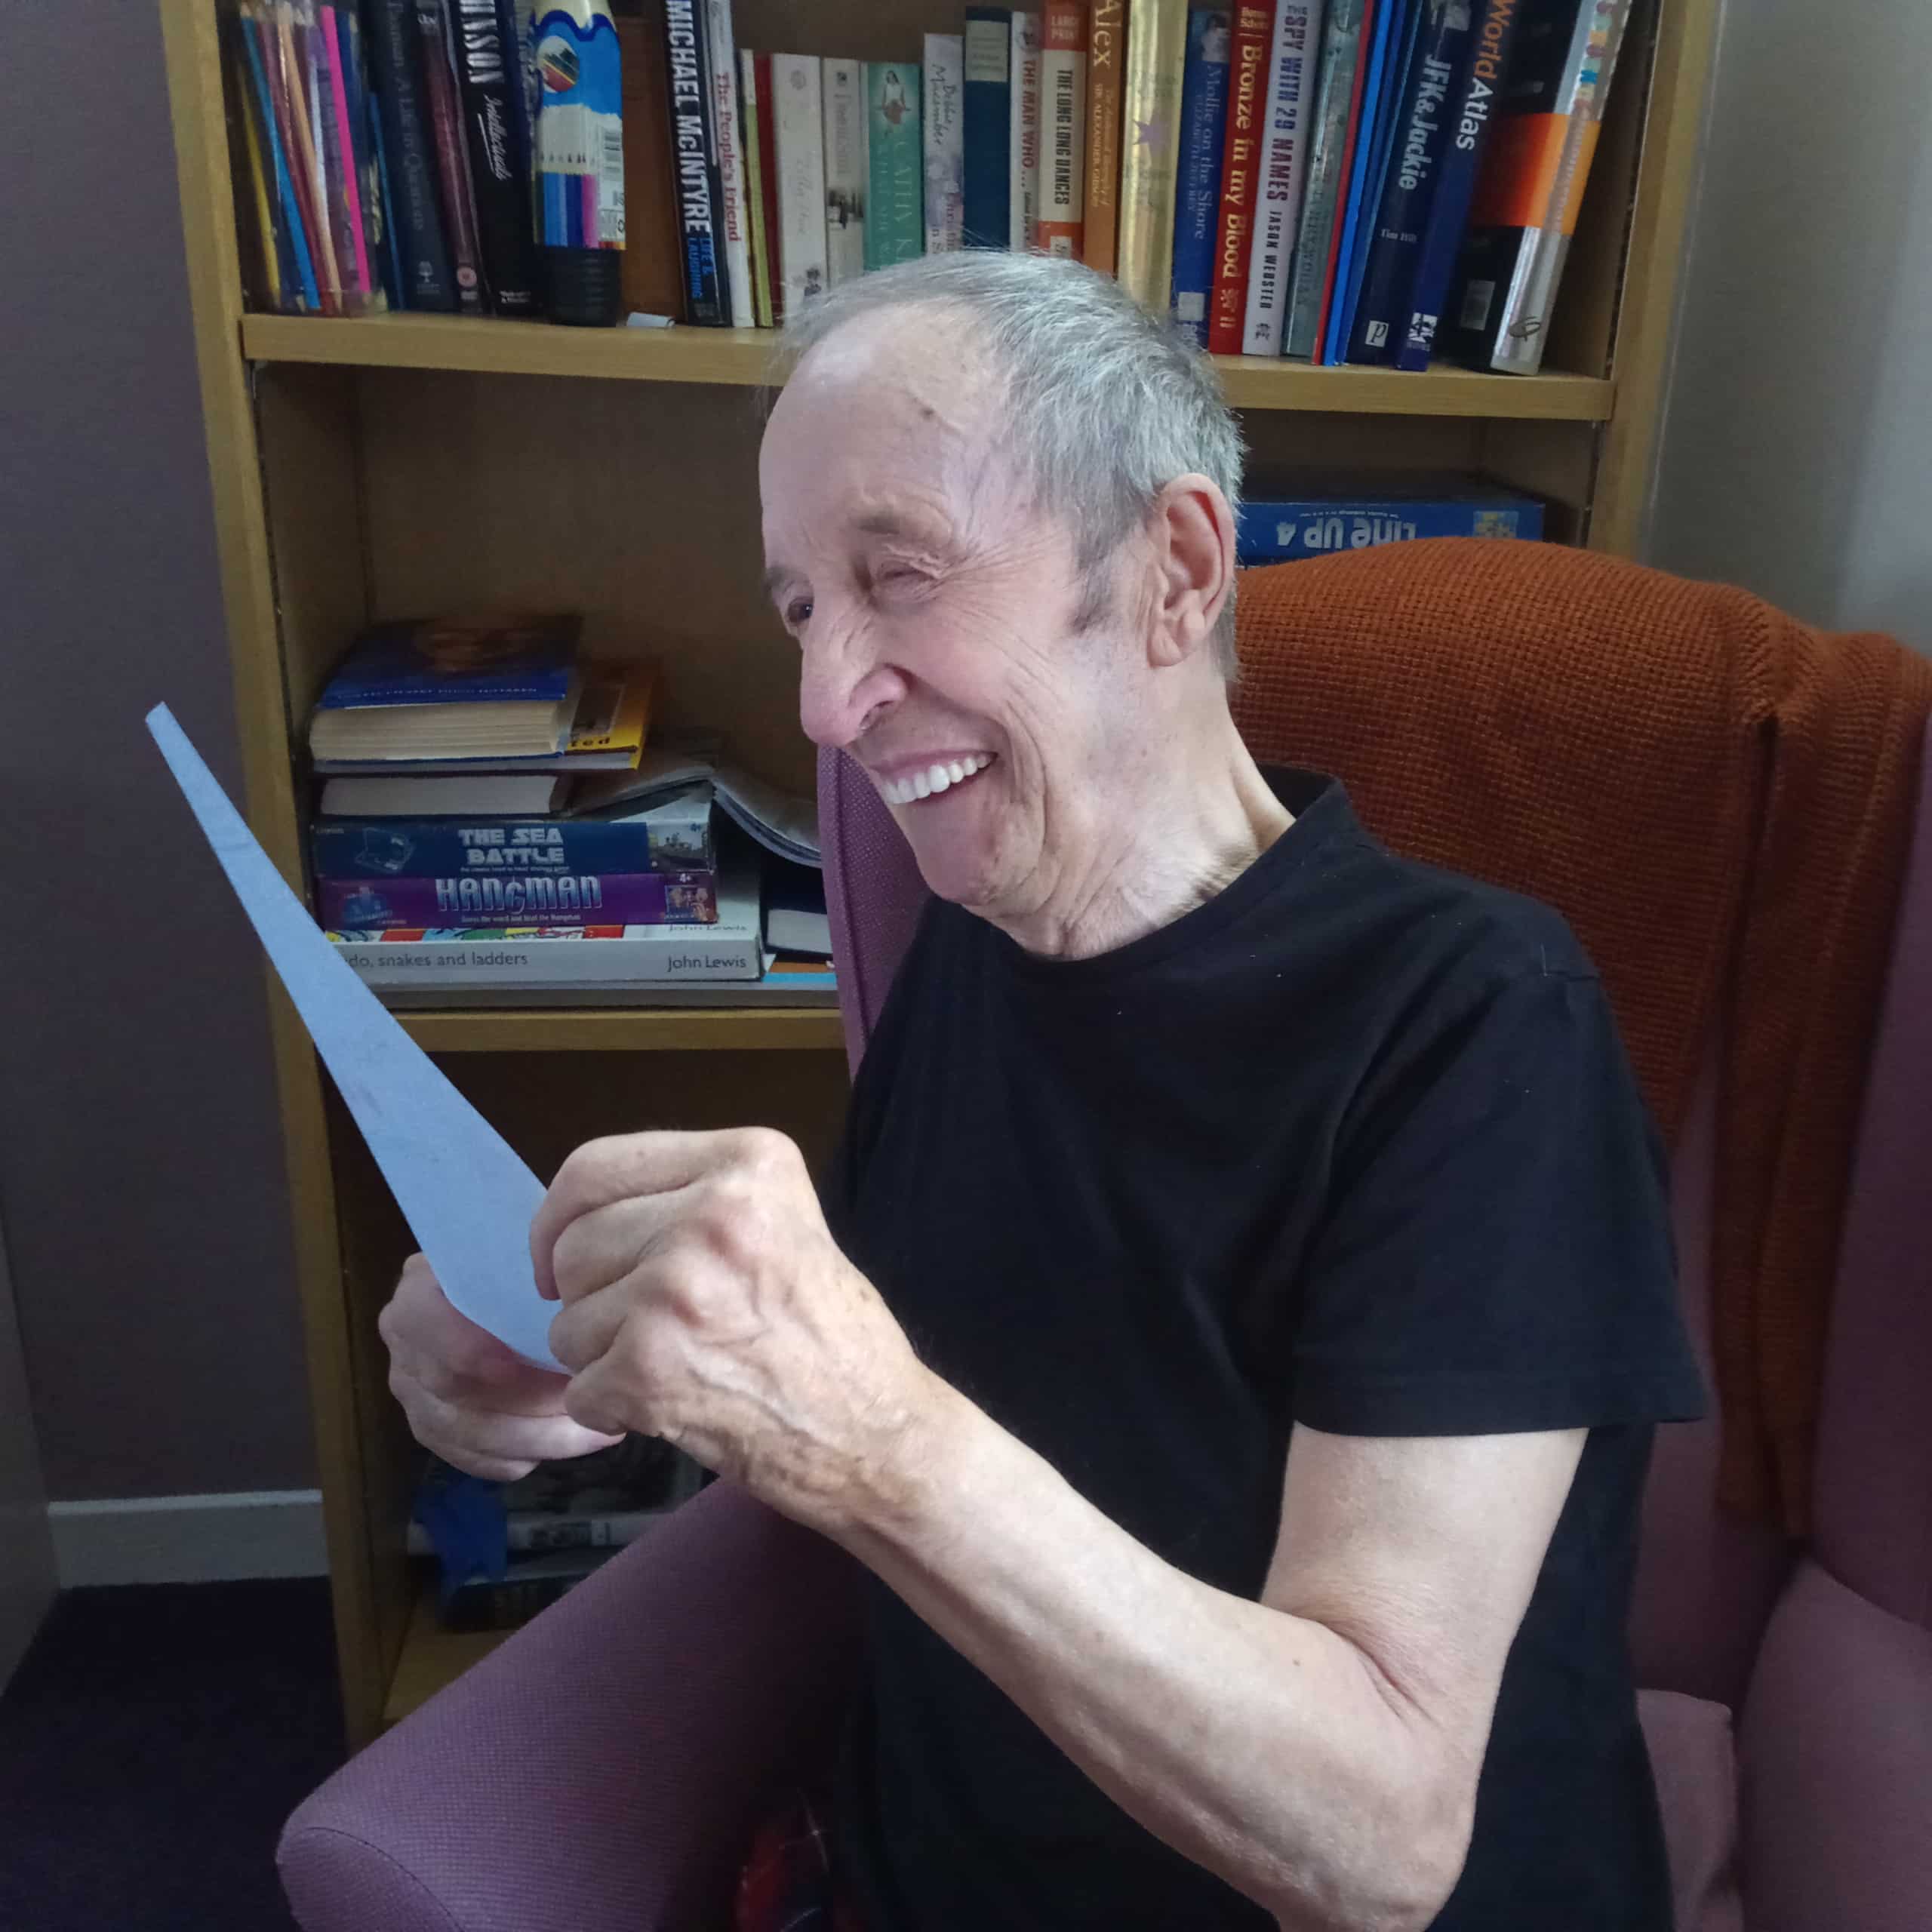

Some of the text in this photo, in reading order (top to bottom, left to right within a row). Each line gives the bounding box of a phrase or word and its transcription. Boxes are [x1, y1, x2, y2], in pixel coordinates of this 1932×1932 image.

[1093, 0, 1121, 67] Alex
[1023, 60, 1036, 85] THE
[1236, 45, 1263, 131] Bronze
[1418, 54, 1452, 102] JFK
[1455, 0, 1516, 151] World Atlas
[484, 93, 513, 182] Intellectuals
[666, 0, 712, 234] MICHAEL McINTYRE
[1022, 90, 1035, 126] MAN
[1054, 69, 1072, 205] THE LONG LONG DANCES
[1267, 15, 1307, 202] SPY WITH 29 NAMES
[717, 72, 741, 242] The People's Friend
[1195, 65, 1221, 240] Mollie on the Shore
[1232, 138, 1254, 162] in
[1398, 115, 1439, 190] Jackie
[1226, 171, 1250, 206] my
[688, 237, 703, 299] LAUGHING
[700, 237, 714, 263] LIFE
[1223, 214, 1245, 278] Blood
[1260, 211, 1282, 309] JASON WEBSTER
[1276, 521, 1297, 546] 4
[1303, 518, 1344, 549] UP
[458, 827, 564, 846] THE SEA
[466, 847, 565, 866] BATTLE
[346, 951, 528, 968] do, snakes and ladders
[666, 955, 747, 973] John Lewis
